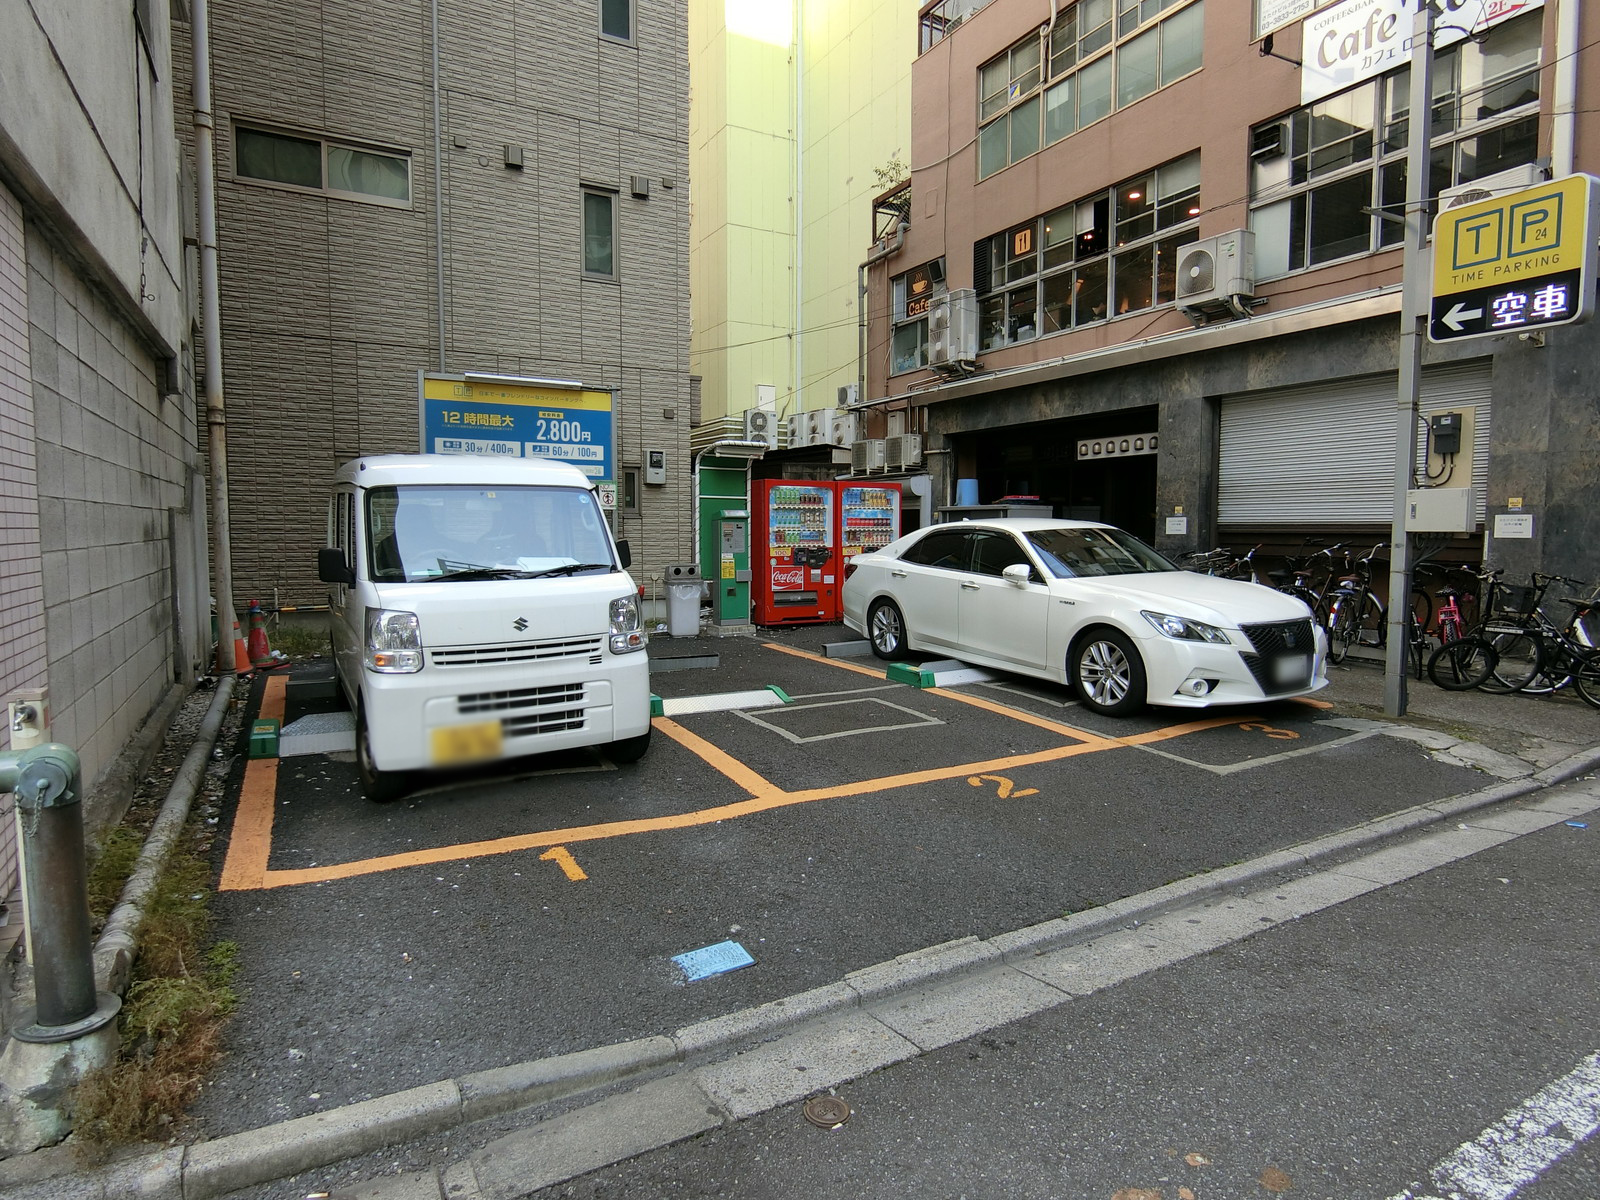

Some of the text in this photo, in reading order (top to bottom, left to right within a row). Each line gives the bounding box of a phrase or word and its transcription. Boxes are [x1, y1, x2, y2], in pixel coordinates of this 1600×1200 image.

[1317, 8, 1397, 69] Cafe
[1535, 227, 1547, 241] 24
[1452, 253, 1560, 285] TIME PARKING
[908, 299, 929, 316] Cafe
[1491, 283, 1567, 327] 空車
[536, 419, 591, 442] 2,800円
[967, 774, 1040, 799] 2
[539, 846, 589, 881] 1
